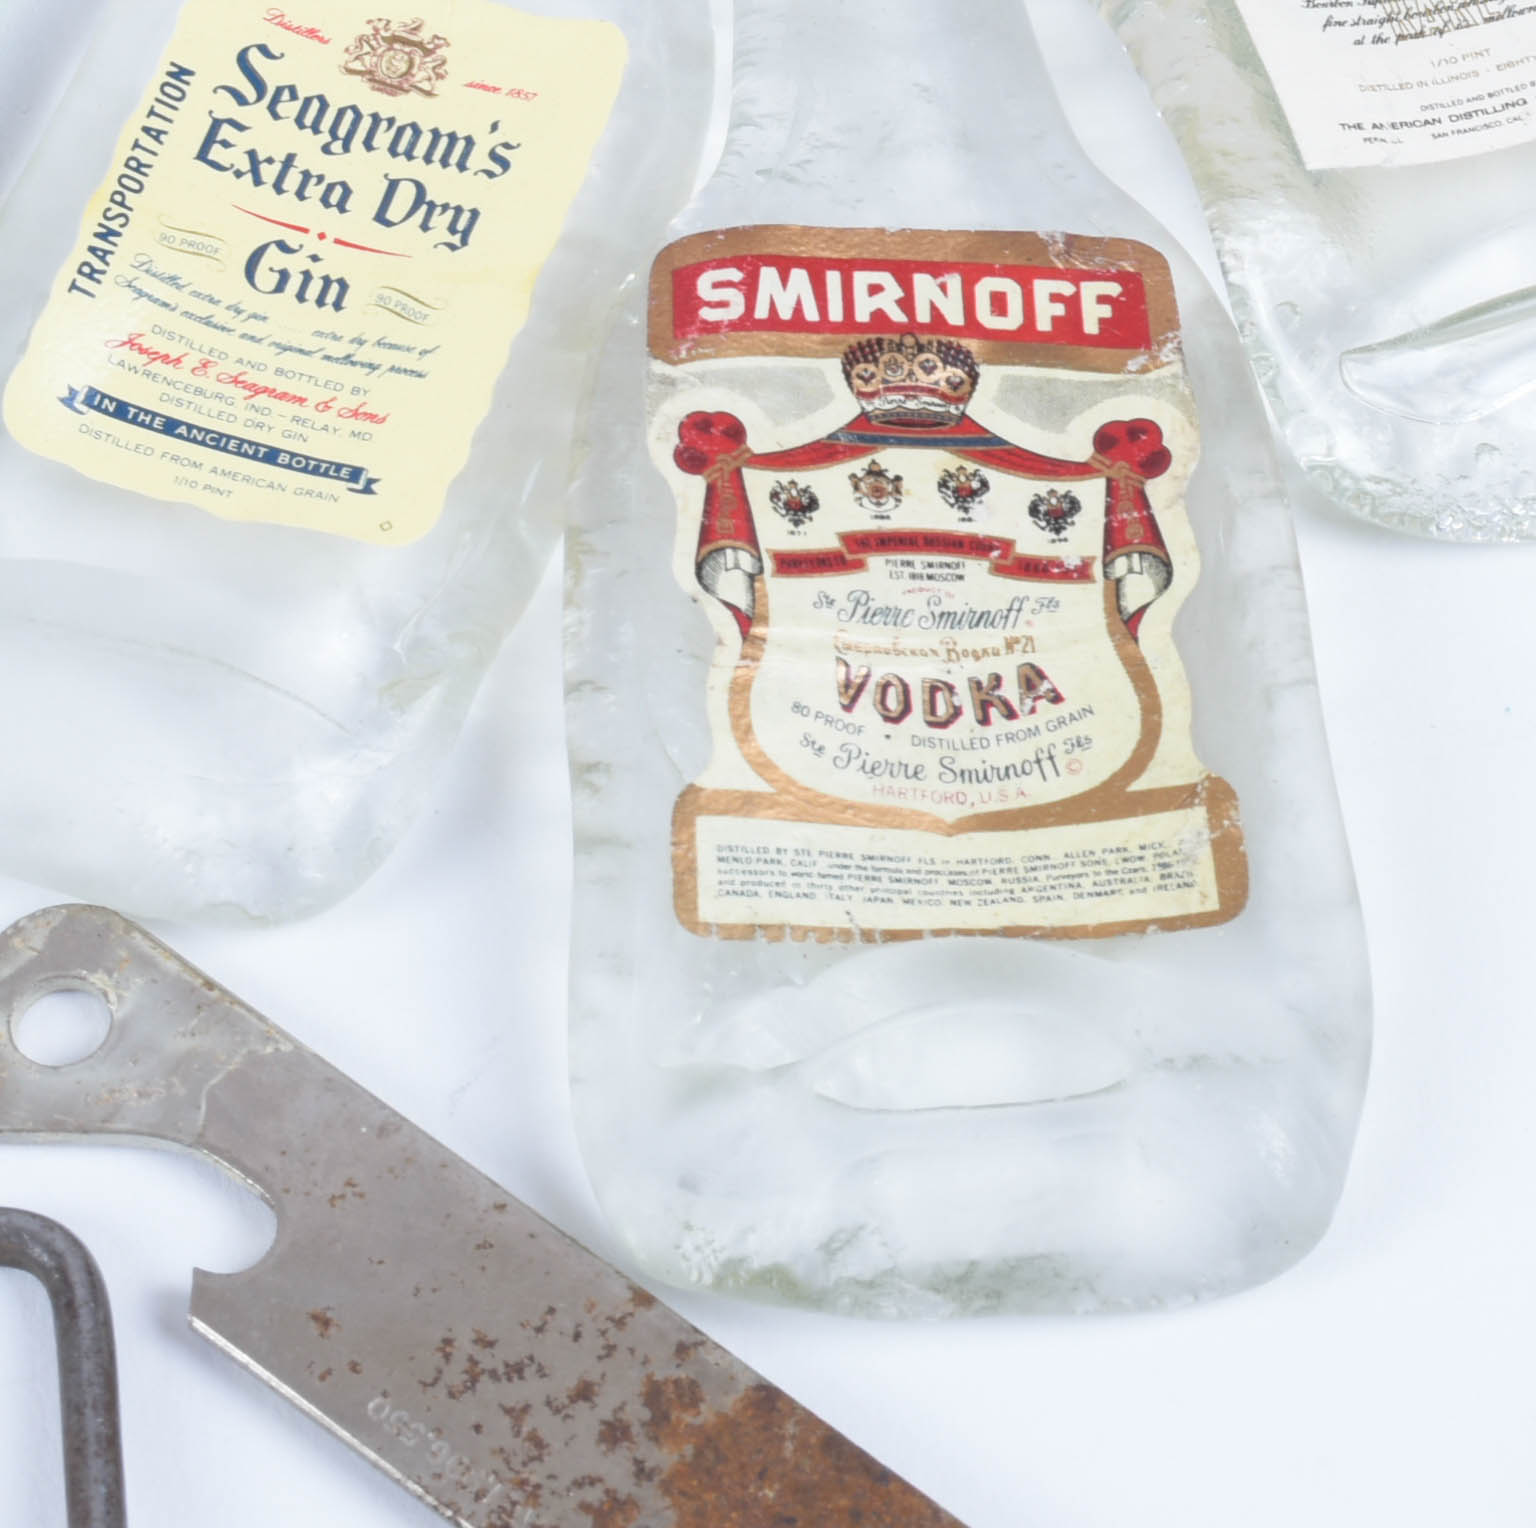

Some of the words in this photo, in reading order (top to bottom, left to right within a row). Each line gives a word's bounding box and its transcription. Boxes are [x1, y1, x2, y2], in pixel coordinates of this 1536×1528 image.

[212, 43, 521, 180] Seagram's
[67, 61, 196, 298] TRANSPORTATION
[193, 109, 354, 215] Extra
[372, 172, 481, 253] Dry
[244, 239, 350, 313] Gin
[694, 263, 1127, 339] SMIRNOFF
[107, 332, 189, 370] Joseph
[215, 371, 309, 408] Seagram
[337, 401, 390, 425] Sons
[150, 323, 230, 361] DISTILLED
[233, 357, 269, 373] AND
[273, 366, 345, 393] BOTTLED
[349, 385, 371, 397] BY
[88, 393, 117, 414] IN
[127, 401, 171, 430] THE
[173, 421, 269, 458] ANCIENT
[276, 448, 353, 485] BOTTLE
[158, 391, 238, 424] DISTILLED
[242, 417, 276, 433] DRY
[280, 428, 309, 444] GIN
[836, 589, 914, 629] Pierre
[918, 595, 1030, 631] Smirnoff
[789, 699, 814, 721] 80
[814, 710, 865, 737] PROOF
[835, 656, 1066, 730] VODKA
[910, 734, 991, 752] DISTILLED
[995, 726, 1042, 747] FROM
[1045, 704, 1095, 733] GRAIN
[832, 742, 926, 782] Pierre
[938, 743, 1061, 785] Smirnoff
